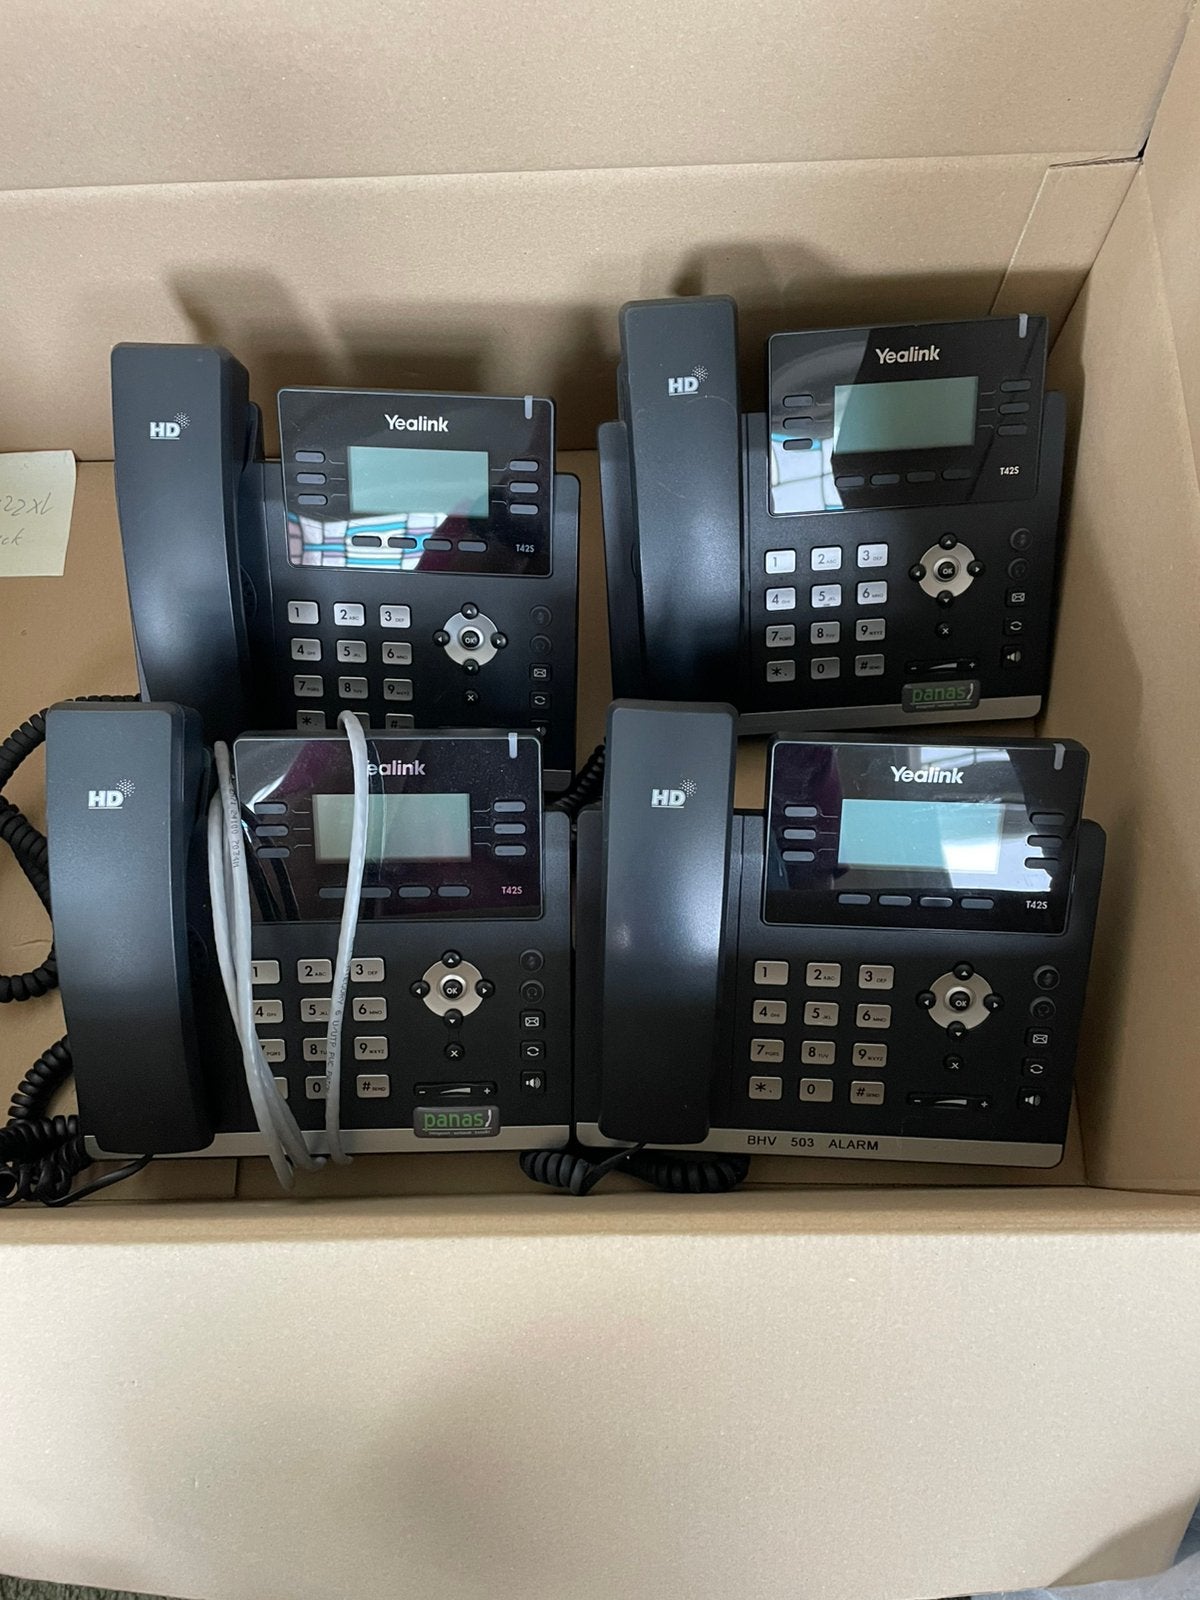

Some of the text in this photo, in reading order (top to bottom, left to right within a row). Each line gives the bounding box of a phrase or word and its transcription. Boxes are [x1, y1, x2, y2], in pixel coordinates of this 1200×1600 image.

[875, 345, 940, 364] Yealink
[668, 376, 699, 393] HD
[150, 421, 181, 437] HD
[384, 414, 449, 432] Yealink
[1000, 466, 1020, 475] T42S
[0, 492, 54, 516] 22XL
[515, 544, 535, 553] T42S
[818, 554, 825, 565] 2
[862, 550, 870, 561] 3
[773, 556, 778, 568] 1
[771, 594, 779, 604] 4
[818, 591, 826, 602] 5
[862, 588, 870, 599] 6
[295, 607, 300, 618] 1
[340, 609, 348, 620] 2
[384, 611, 392, 622] 3
[771, 631, 779, 642] 7
[816, 628, 824, 639] 8
[861, 625, 869, 636] 9
[297, 645, 305, 656] 4
[343, 646, 351, 657] 5
[387, 648, 395, 659] 6
[817, 664, 825, 674] 0
[298, 681, 306, 691] 7
[344, 682, 351, 693] 8
[387, 684, 395, 695] 9
[367, 760, 426, 776] ealink
[890, 766, 964, 784] Yealink
[88, 790, 124, 807] HD
[651, 789, 686, 806] HD
[501, 886, 523, 895] T42S
[1025, 900, 1048, 909] T42S
[253, 966, 259, 978] 1
[304, 965, 313, 977] 2
[355, 964, 364, 976] 3
[762, 966, 768, 978] 1
[813, 968, 822, 980] 2
[864, 970, 873, 982] 3
[255, 1006, 265, 1017] 4
[308, 1004, 316, 1016] 5
[358, 1003, 367, 1015] 6
[759, 1006, 768, 1017] 4
[811, 1007, 820, 1019] 5
[862, 1010, 871, 1022] 6
[310, 1043, 318, 1055] 8
[359, 1042, 368, 1054] 9
[756, 1044, 765, 1056] 7
[808, 1046, 816, 1058] 8
[858, 1048, 867, 1060] 9
[312, 1081, 321, 1093] 0
[807, 1083, 815, 1095] 0
[424, 1113, 484, 1131] panas
[747, 1134, 879, 1151] BHV 503 ALARM
